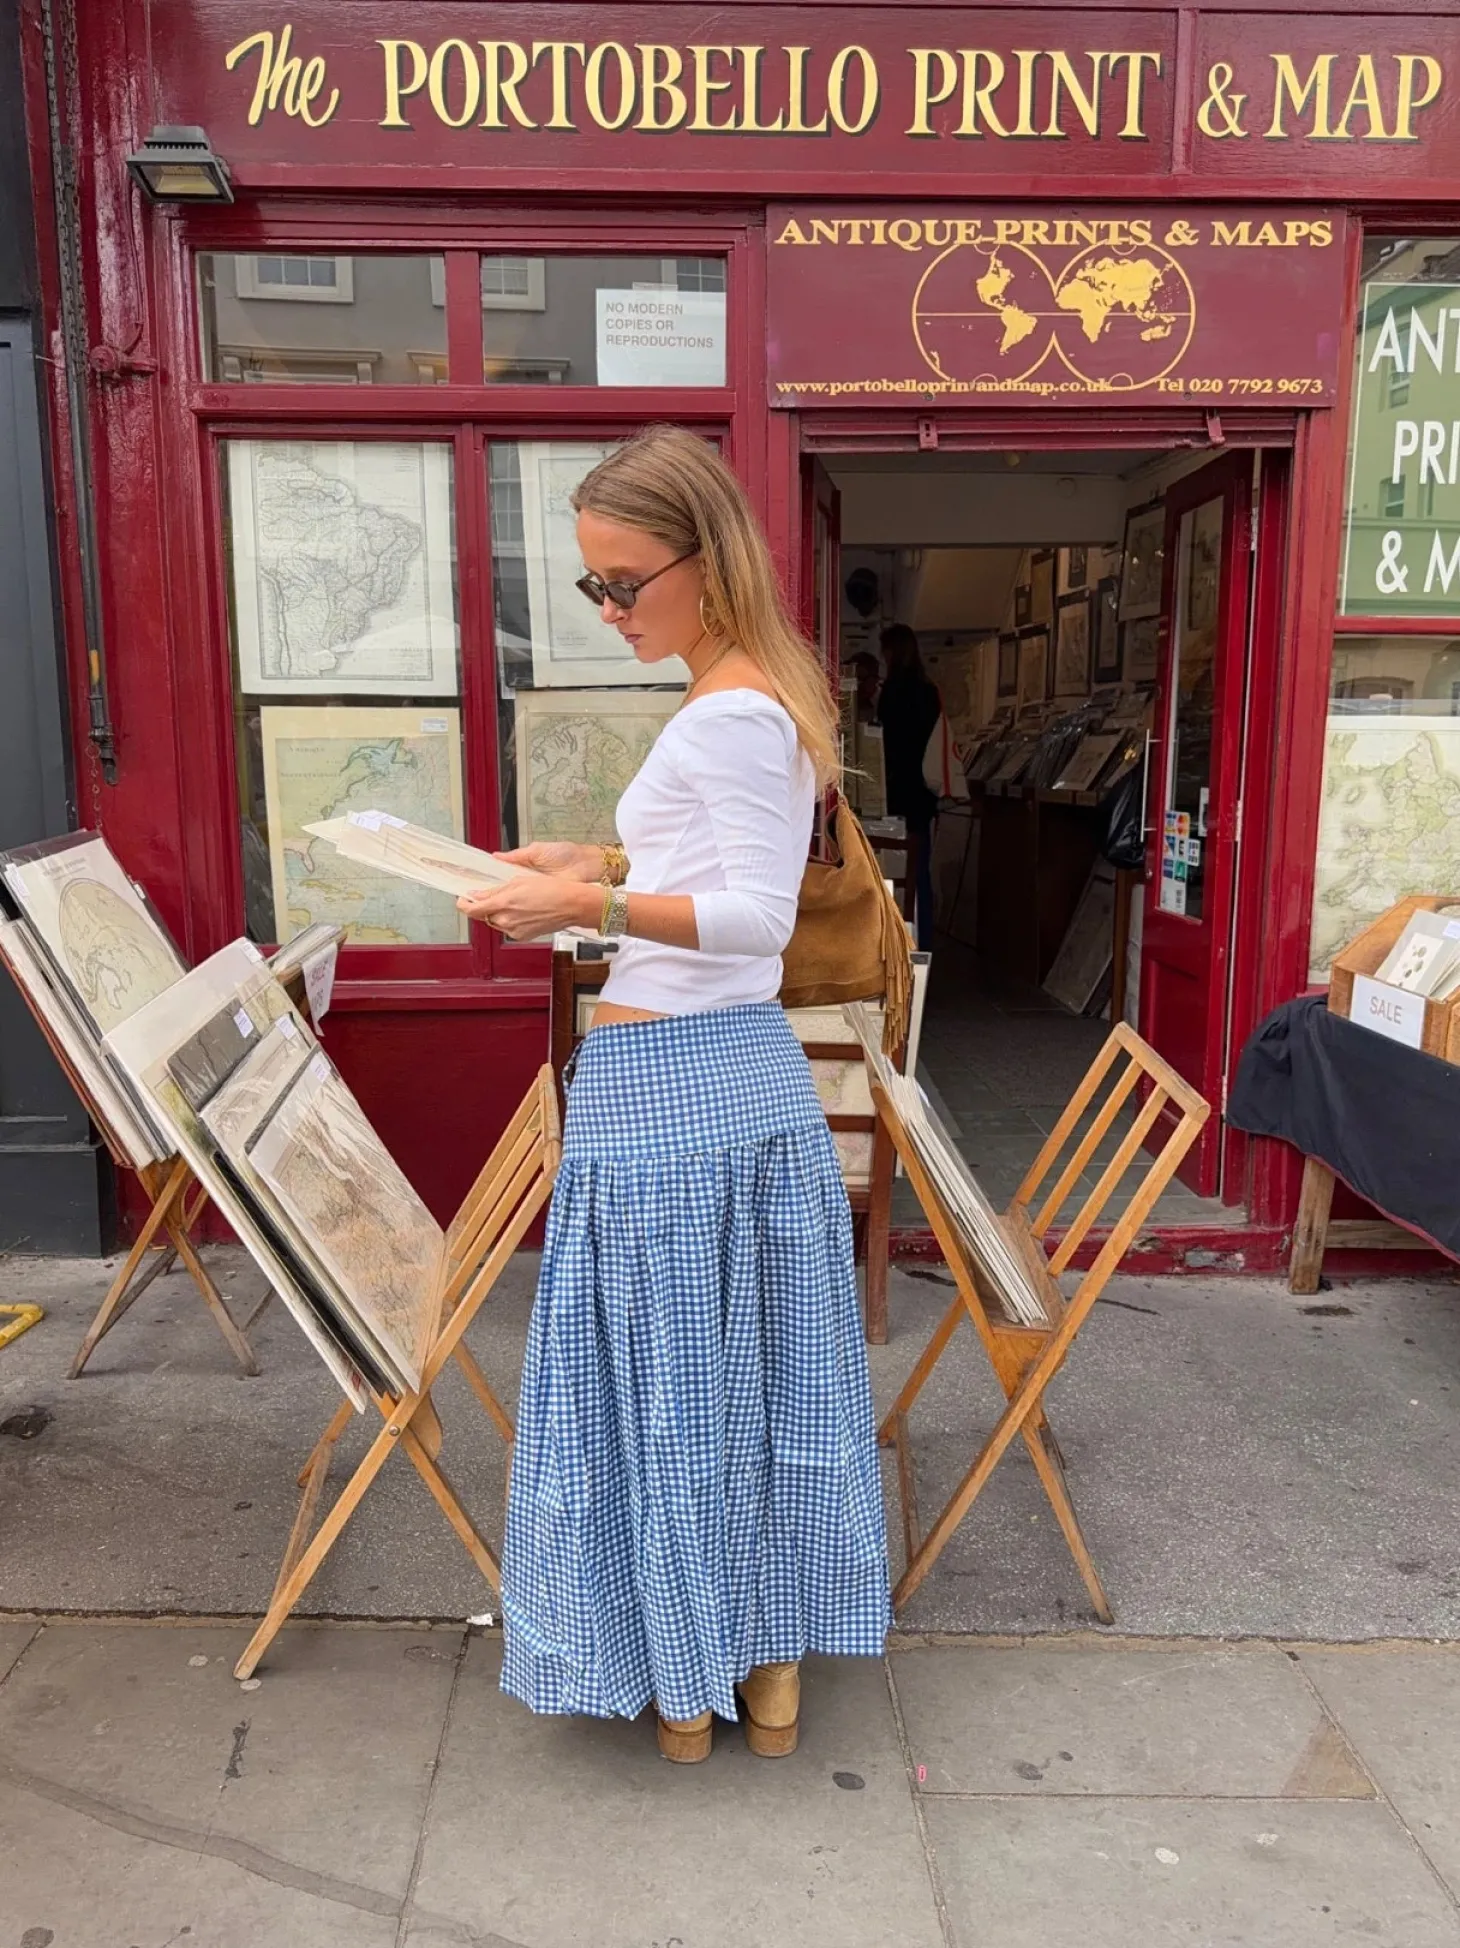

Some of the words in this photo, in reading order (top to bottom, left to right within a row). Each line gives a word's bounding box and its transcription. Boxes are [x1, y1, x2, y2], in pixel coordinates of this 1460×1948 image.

[225, 23, 340, 127] The
[375, 38, 879, 135] PORTOBELLO
[904, 48, 1162, 138] PRINT
[1197, 62, 1249, 138] &
[1263, 53, 1443, 141] MAP
[774, 218, 982, 250] ANTIQUE
[993, 219, 1152, 246] PRINTS
[1164, 220, 1200, 247] &
[1210, 220, 1333, 247] MAPS
[606, 303, 624, 313] NO
[628, 303, 683, 315] MODERN
[606, 319, 653, 330] COPIES
[655, 320, 674, 331] OR
[606, 335, 713, 348] REPRODUCTIONS
[1157, 378, 1185, 393] Tel
[1189, 378, 1223, 393] 020
[1228, 379, 1273, 394] 7792
[1277, 379, 1323, 394] 9673
[1375, 530, 1409, 594] &
[1369, 996, 1403, 1025] SALE
